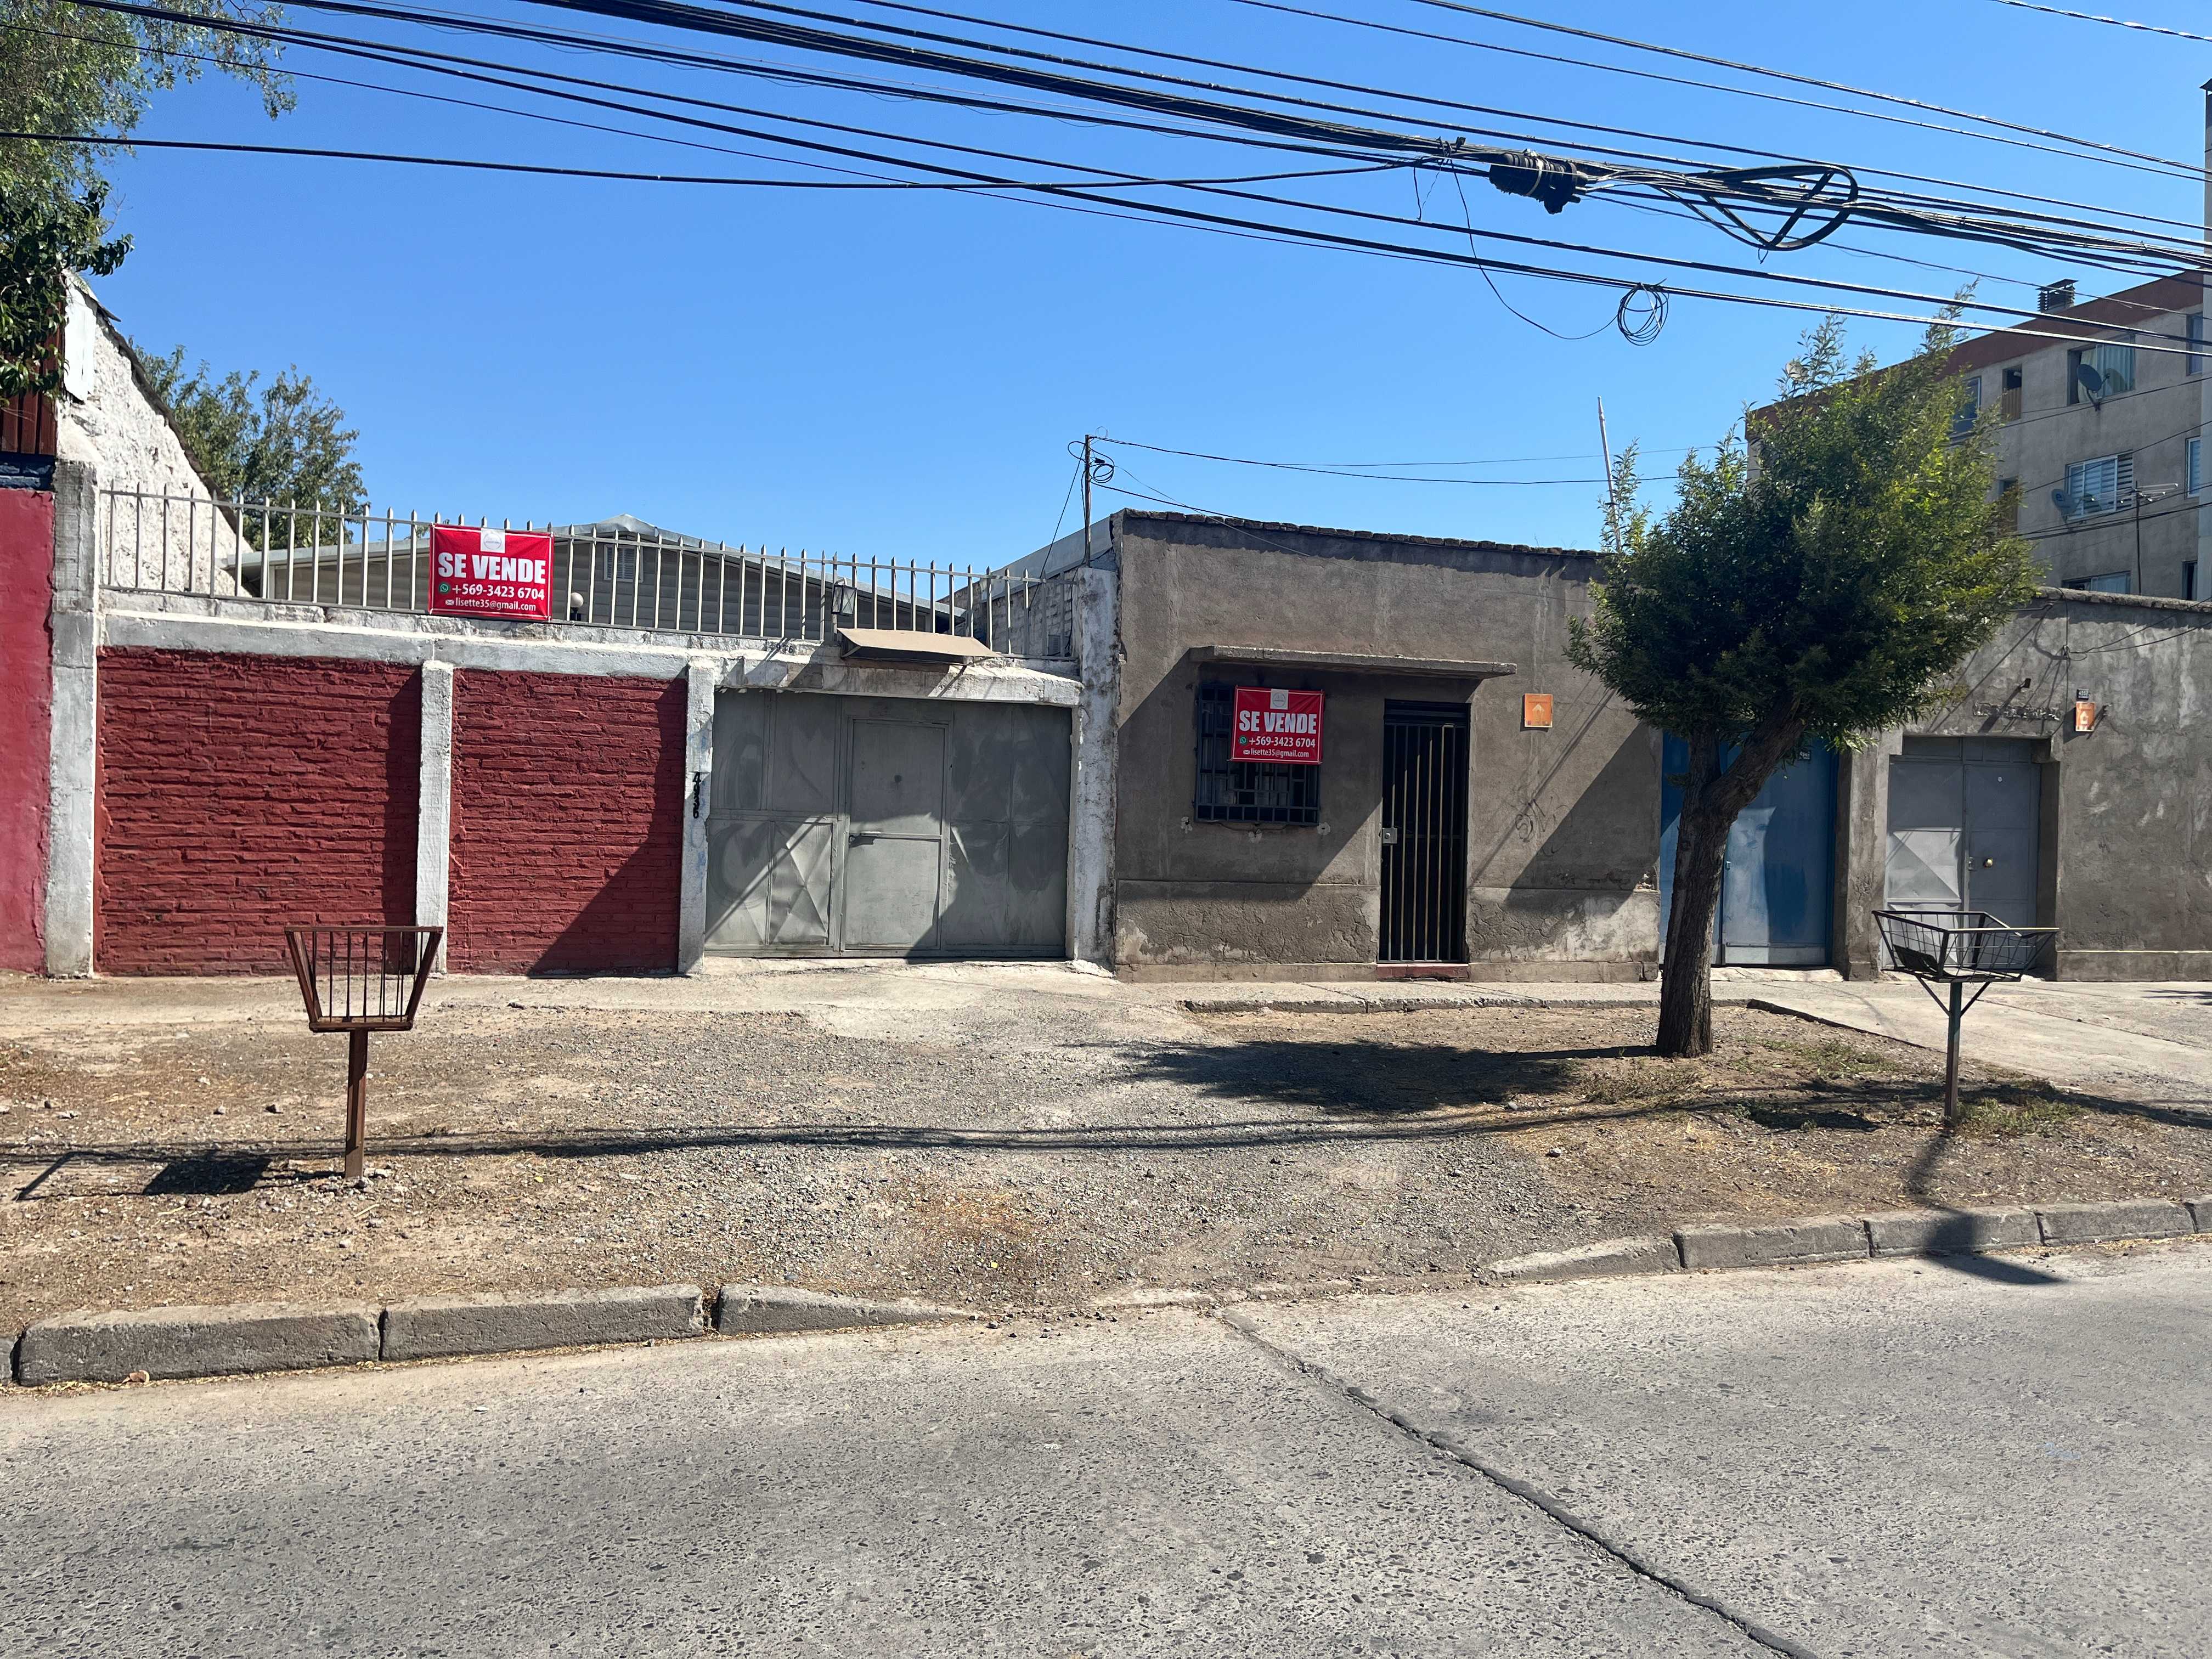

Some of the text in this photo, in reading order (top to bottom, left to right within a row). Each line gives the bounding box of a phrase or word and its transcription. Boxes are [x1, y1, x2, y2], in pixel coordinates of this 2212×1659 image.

[438, 552, 546, 584] SE VENDE
[452, 583, 545, 600] +569-3423 6704
[456, 597, 536, 611] lisette35@gmail.com
[1239, 710, 1317, 734] SE VENDE
[1249, 736, 1316, 748] +569-3423 6704
[1250, 748, 1309, 758] lisette35@gmail.com
[692, 771, 701, 819] 4936
